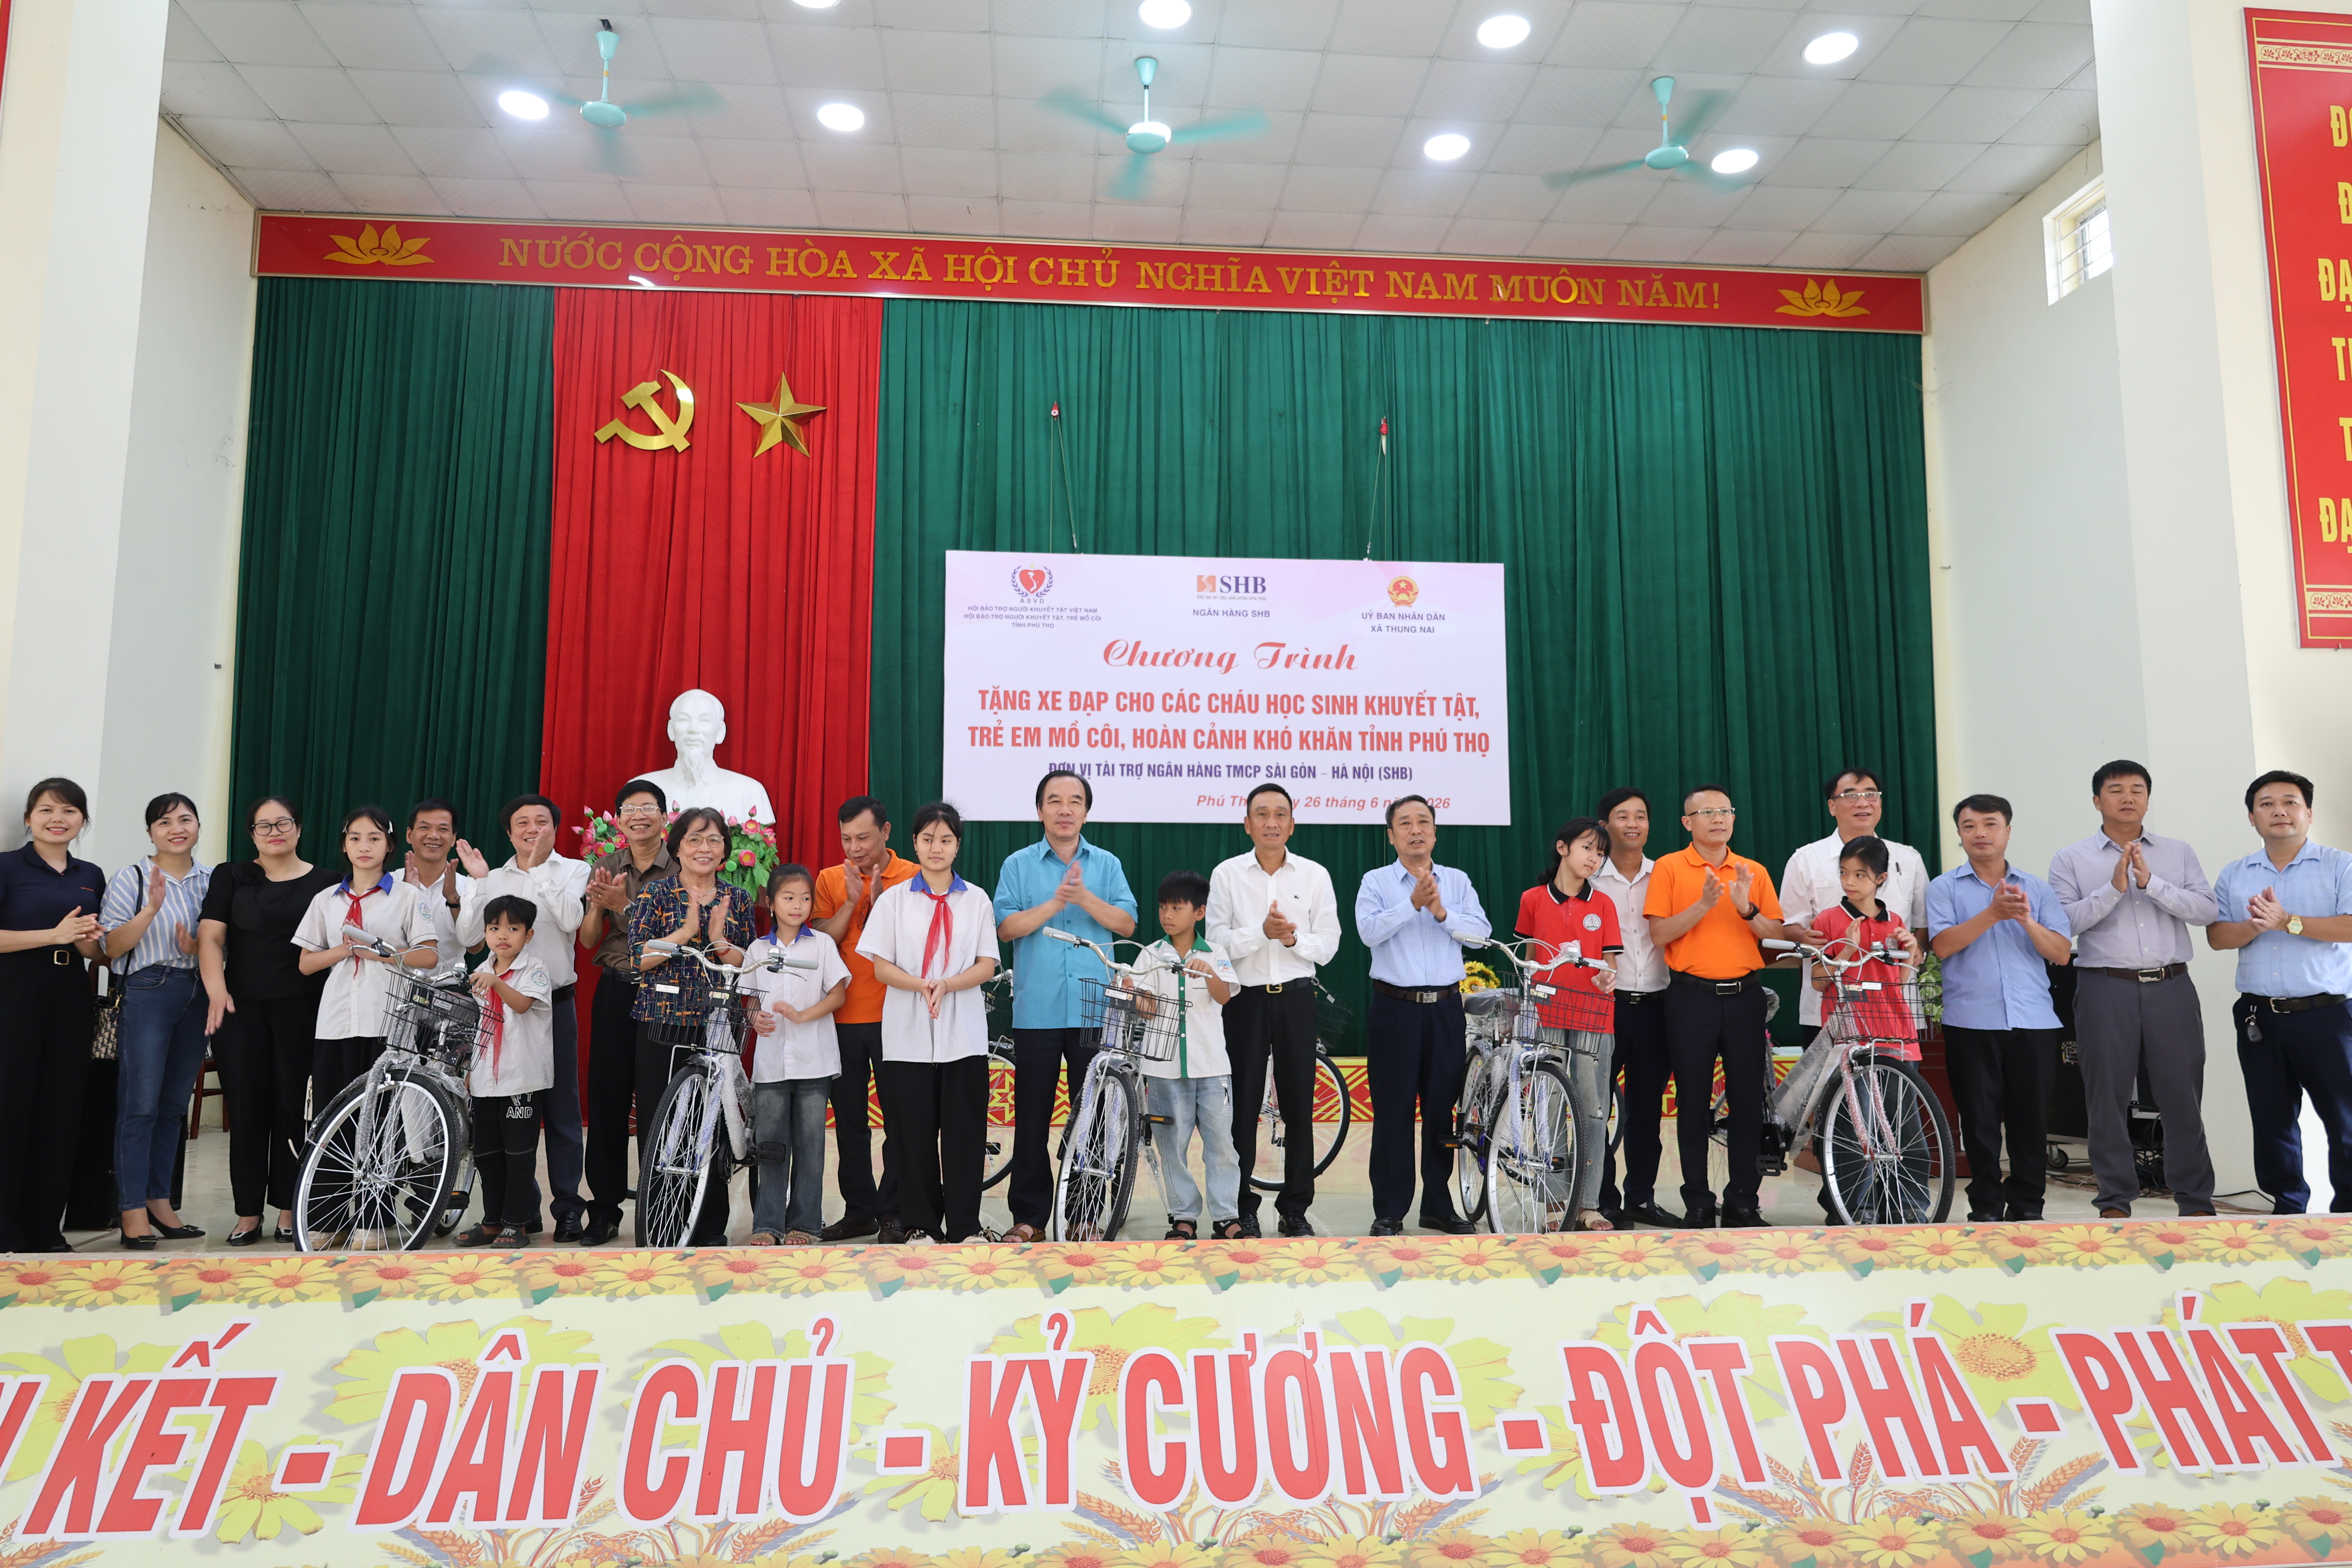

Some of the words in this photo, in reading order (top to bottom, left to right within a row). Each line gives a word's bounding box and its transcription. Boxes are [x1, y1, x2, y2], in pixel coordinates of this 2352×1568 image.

[2330, 105, 2352, 147] Đ
[499, 232, 622, 270] NƯỚC
[635, 235, 753, 281] CỘNG
[766, 239, 857, 278] HÒA
[868, 247, 932, 280] XÃ
[944, 247, 1018, 291] HỘI
[1029, 247, 1120, 287] CHỦ
[1136, 257, 1272, 292] NGHĨA
[1277, 260, 1374, 303] VIỆT
[1386, 271, 1478, 300] NAM
[1489, 268, 1606, 305] MUÔN
[1617, 274, 1719, 309] NĂM!
[1220, 576, 1266, 593] SHB
[1193, 608, 1219, 616] NGÂN
[1223, 608, 1248, 617] HÀNG
[1362, 610, 1373, 619] UỶ
[1399, 612, 1423, 620] NHÂN
[1427, 612, 1445, 621] DÂN
[1103, 640, 1238, 674] Chương
[1254, 642, 1357, 670] Trình
[978, 686, 1030, 715] TẶNG
[1038, 691, 1062, 711] XE
[1069, 691, 1108, 716] ĐẠP
[1116, 692, 1154, 712] CHO
[1162, 689, 1200, 713] CÁC
[1208, 690, 1259, 714] CHÁU
[1267, 694, 1304, 719] HỌC
[1312, 695, 1357, 715] SINH
[1365, 690, 1436, 716] KHUYẾT
[1443, 693, 1479, 721] TẬT,
[968, 719, 1004, 746] TRẺ
[1011, 727, 1041, 747] EM
[1049, 720, 1080, 748] MỒ
[1087, 724, 1125, 751] CÔI,
[1133, 724, 1186, 749] HOÀN
[1194, 722, 1246, 750] CẢNH
[1254, 726, 1292, 750] KHÓ
[1299, 727, 1352, 751] KHĂN
[1358, 724, 1402, 751] TỈNH
[1409, 728, 1447, 752] PHÚ
[1454, 733, 1489, 757] THỌ
[1080, 763, 1091, 779] VỊ
[1096, 761, 1114, 776] TÀI
[1119, 763, 1143, 780] TRỢ
[1148, 762, 1182, 777] NGÂN
[1187, 762, 1221, 777] HÀNG
[1226, 765, 1261, 778] TMCP
[1266, 763, 1285, 778] SÀI
[1291, 762, 1316, 779] GÒN
[1332, 764, 1348, 779] HÀ
[1353, 764, 1373, 782] NỘI
[1379, 767, 1412, 781] (SHB)
[1197, 795, 1225, 807] Phú
[1230, 795, 1248, 807] Th
[1304, 797, 1321, 808] 26
[1326, 797, 1366, 811] tháng
[1370, 797, 1378, 809] 6
[1426, 797, 1450, 809] 026
[506, 1106, 533, 1118] AND
[22, 1323, 276, 1534] KẾT
[356, 1334, 598, 1525] DÂN
[623, 1318, 851, 1520] CHỦ
[966, 1313, 1089, 1507] KỶ
[1125, 1333, 1473, 1504] CƯƠNG
[1563, 1310, 1766, 1523] ĐỘT
[1776, 1302, 2012, 1480] PHÁ
[2056, 1296, 2334, 1469] PHÁT
